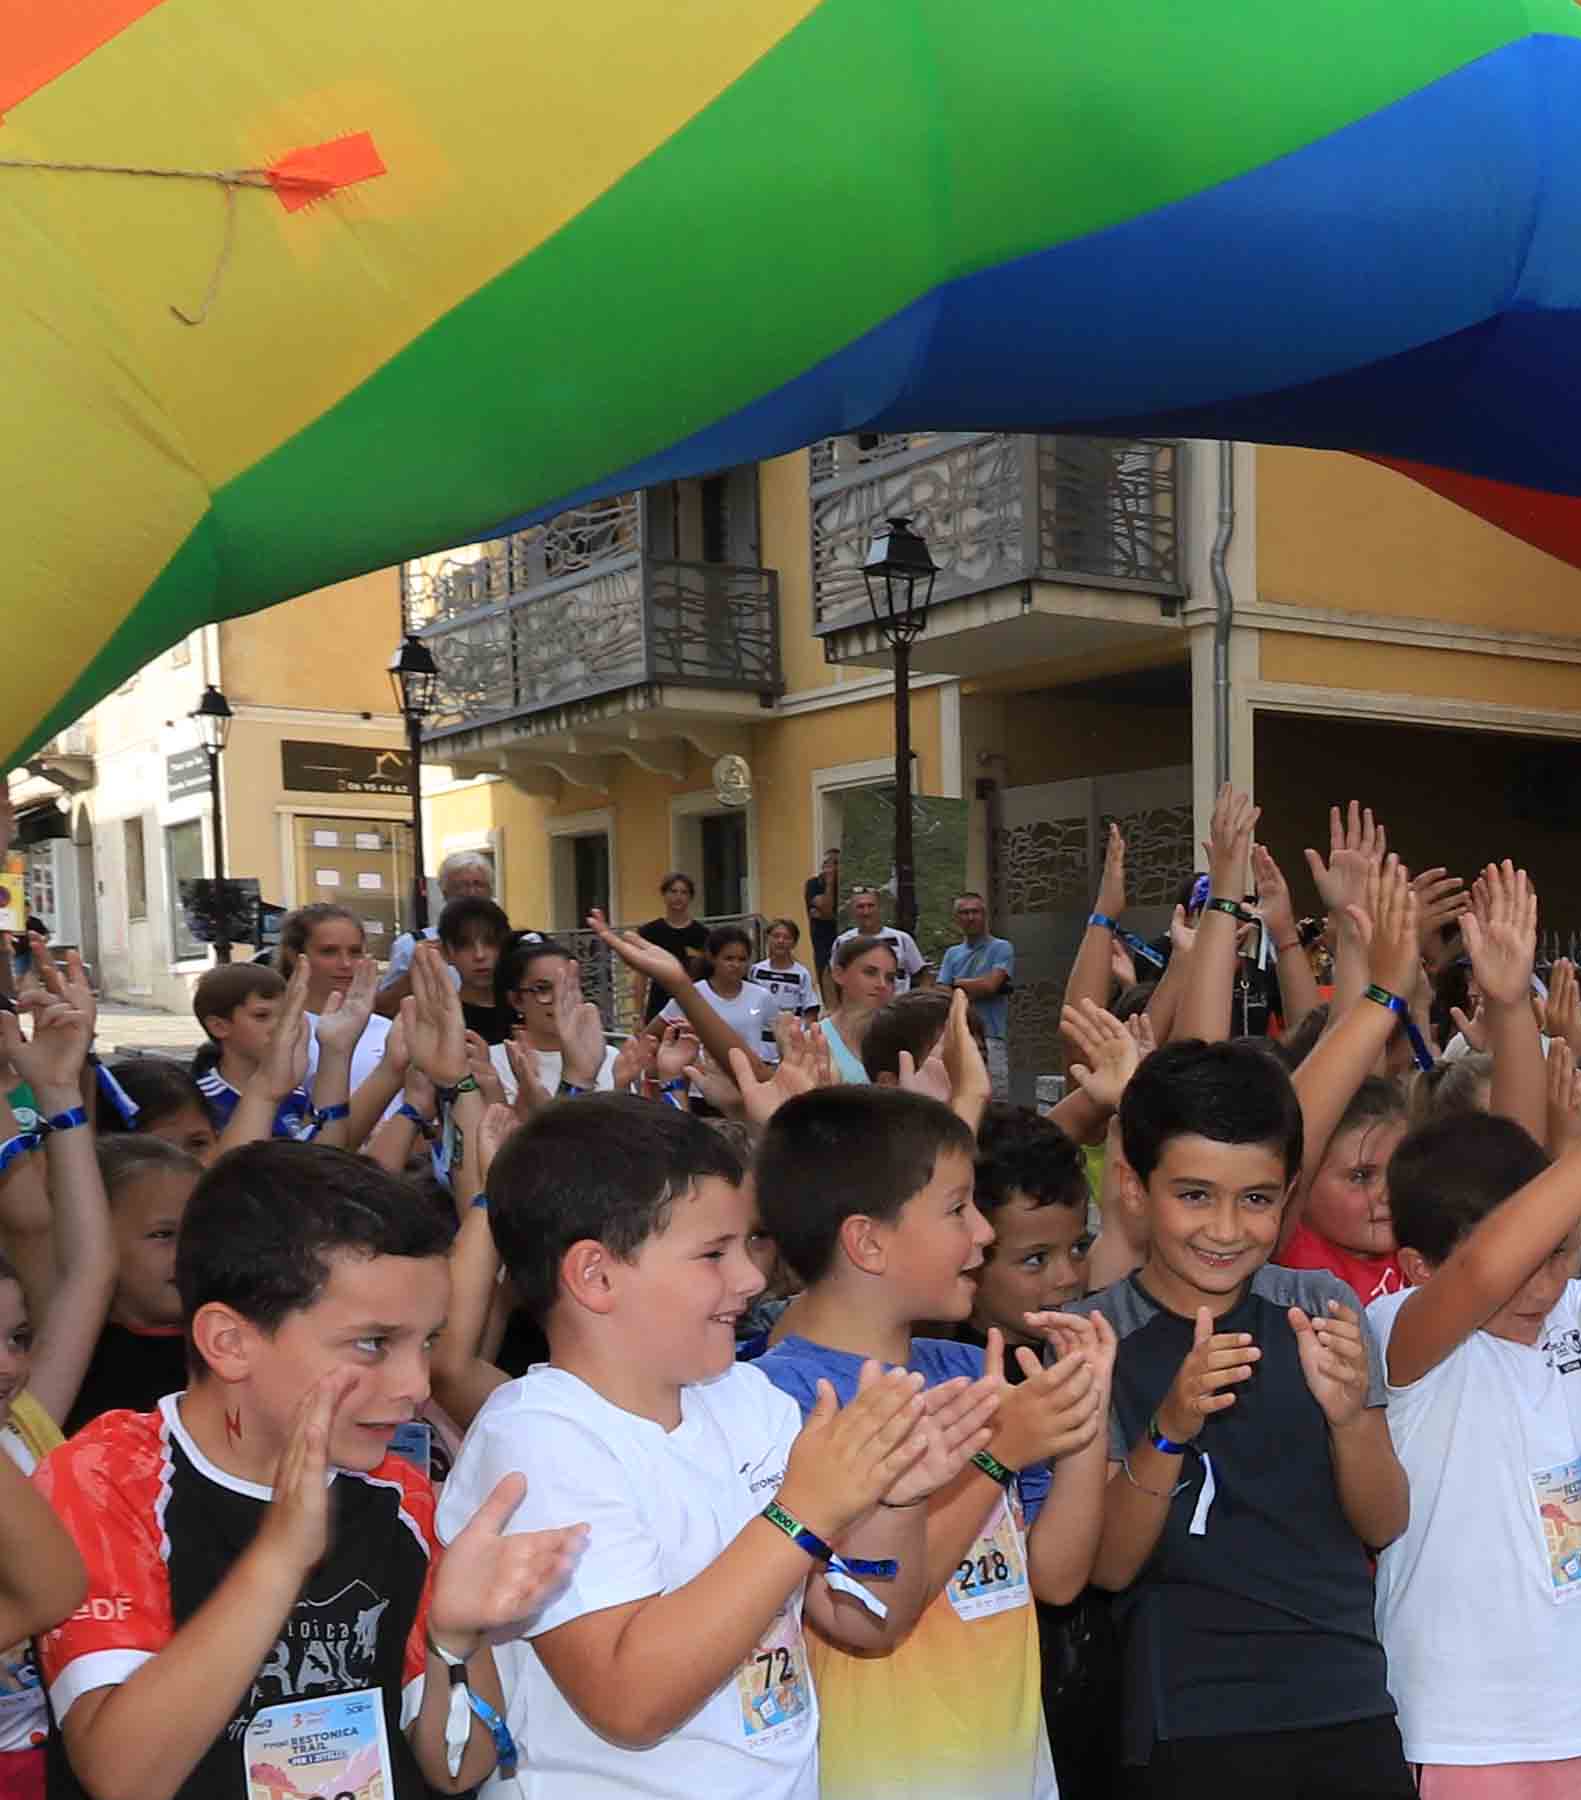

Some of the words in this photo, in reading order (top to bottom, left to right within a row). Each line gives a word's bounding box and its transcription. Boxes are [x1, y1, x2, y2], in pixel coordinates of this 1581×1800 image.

[958, 1552, 1009, 1591] 218
[755, 1646, 793, 1689] 72
[290, 1726, 360, 1746] RESTONICA
[292, 1741, 330, 1755] TRAIL
